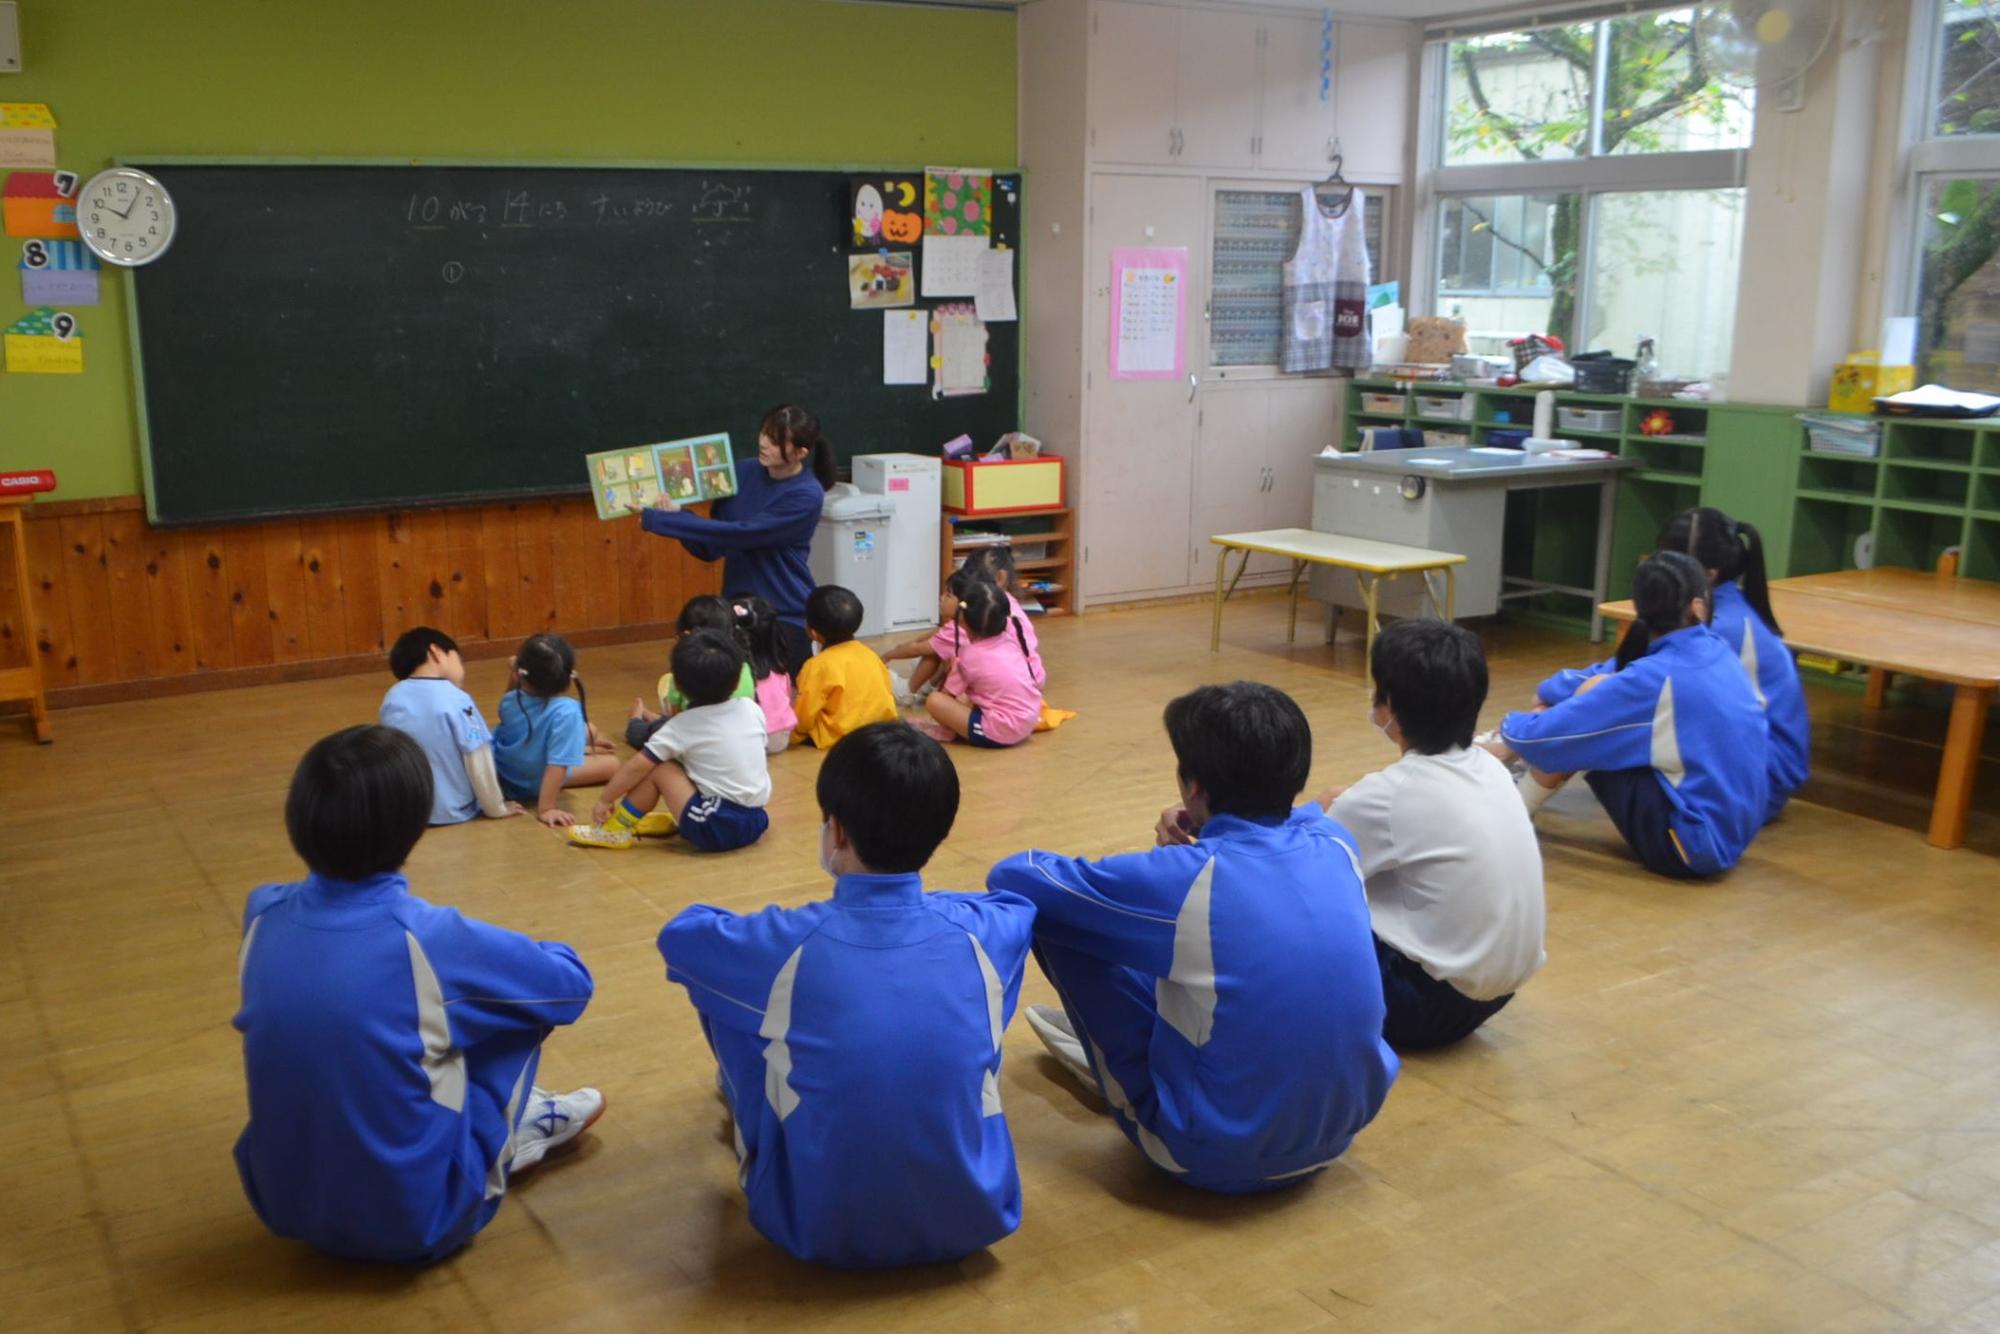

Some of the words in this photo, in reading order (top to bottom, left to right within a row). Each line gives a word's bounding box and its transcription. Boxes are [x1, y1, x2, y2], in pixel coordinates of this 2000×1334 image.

[56, 173, 76, 195] 7
[116, 182, 128, 193] 12
[102, 187, 112, 197] 11
[93, 198, 105, 209] 10
[145, 196, 154, 207] 2
[90, 213, 99, 224] 9
[150, 210, 159, 221] 3
[96, 227, 106, 238] 8
[148, 225, 157, 236] 4
[109, 237, 117, 249] 7
[124, 241, 134, 252] 6
[138, 236, 148, 248] 5
[25, 242, 47, 266] 8
[53, 314, 74, 339] 9
